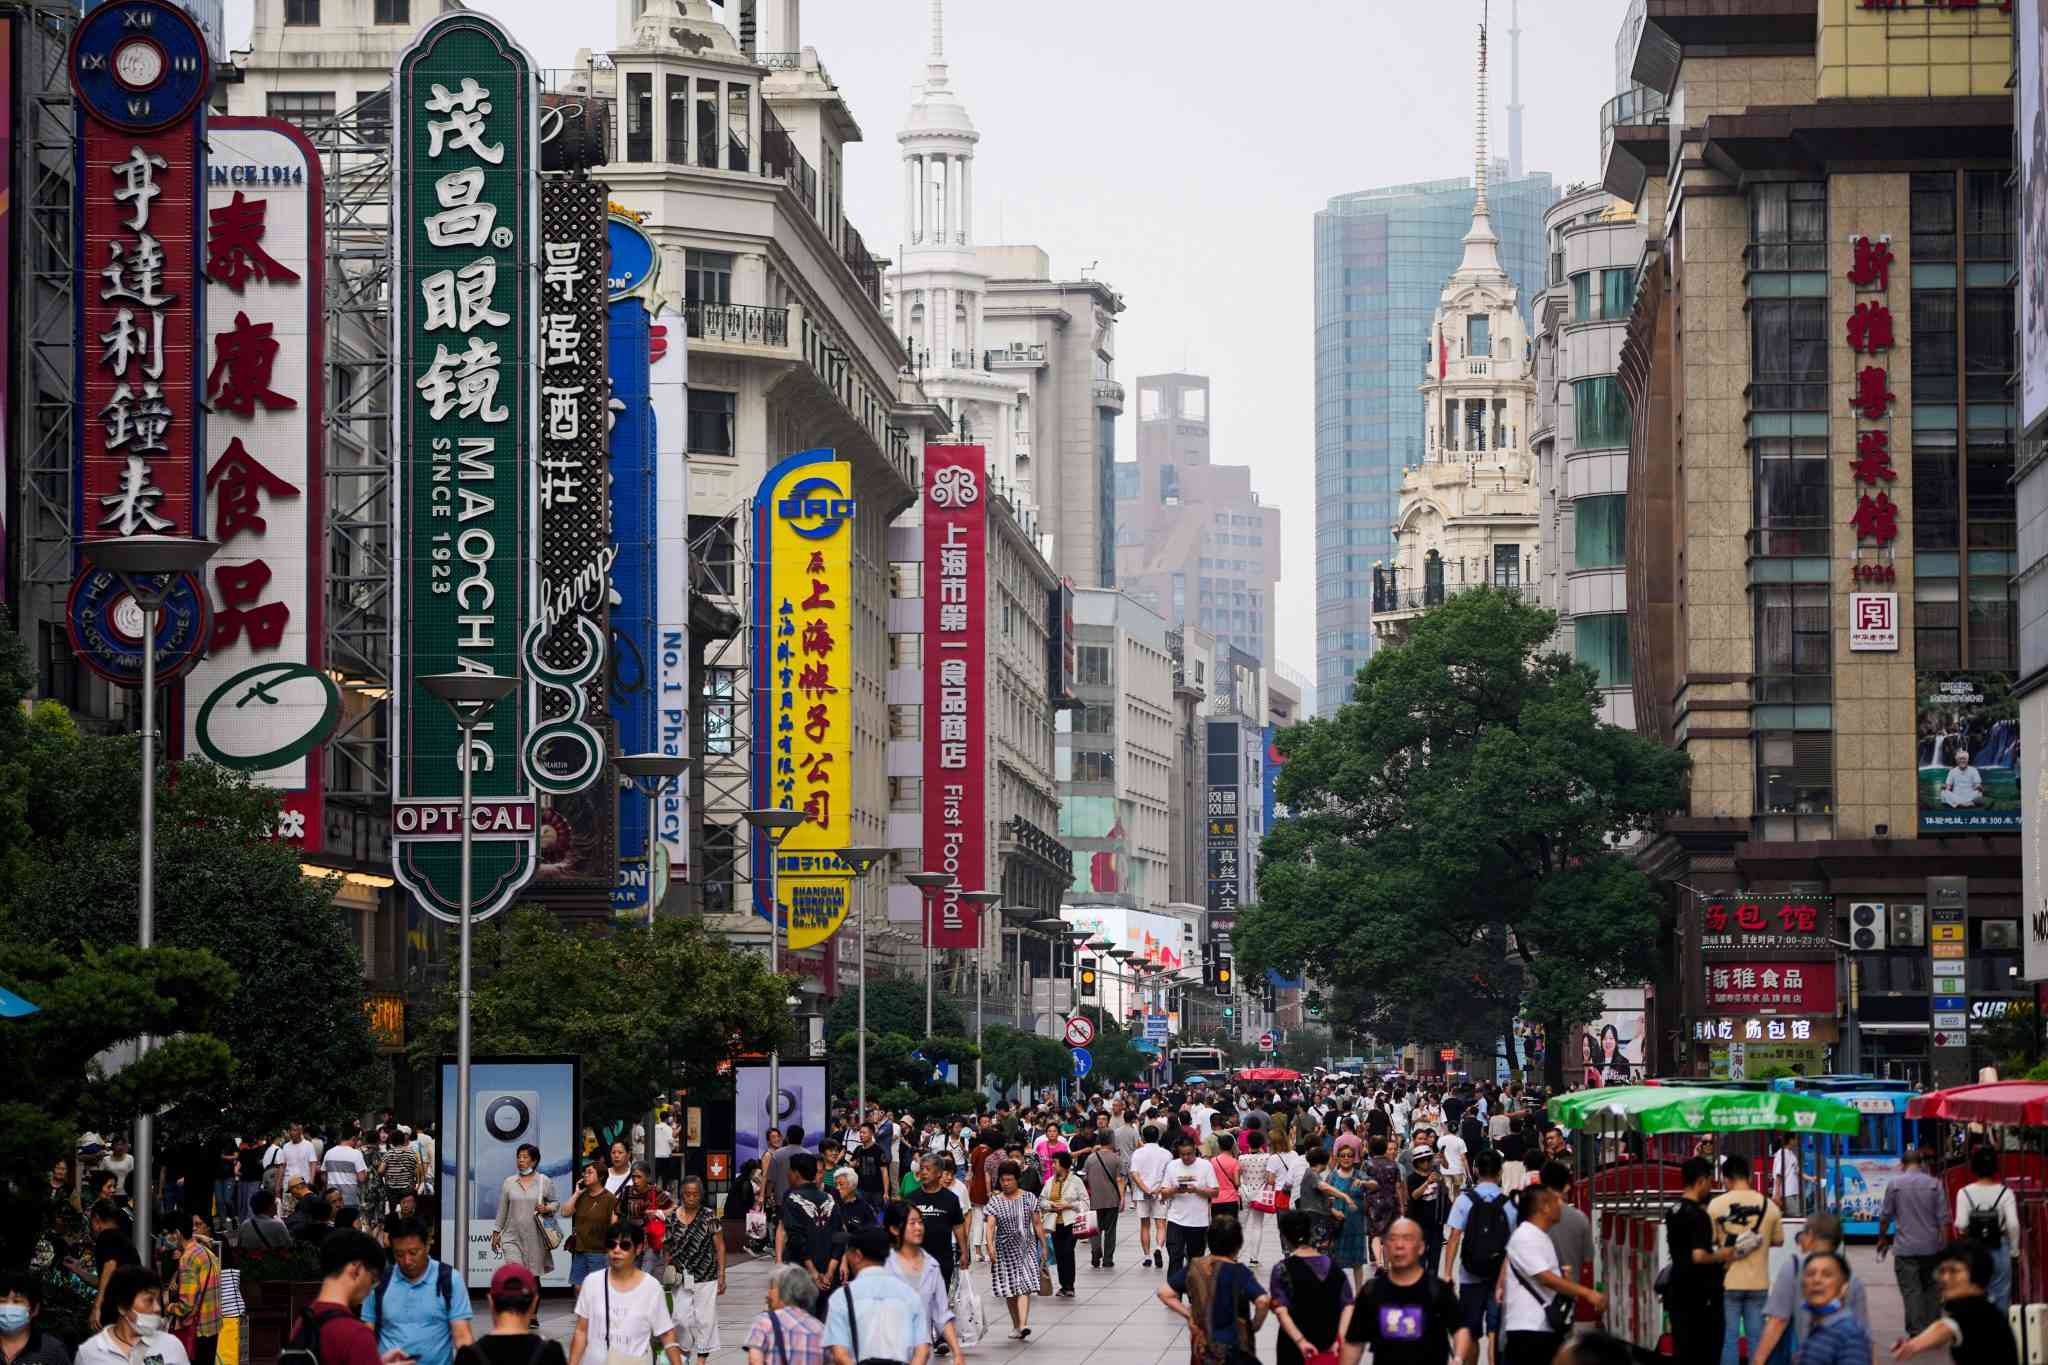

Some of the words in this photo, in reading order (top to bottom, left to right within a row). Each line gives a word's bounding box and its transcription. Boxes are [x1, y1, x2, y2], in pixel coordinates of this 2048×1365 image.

[416, 77, 511, 423] 茂昌眼镜
[205, 190, 303, 656] 泰康食品
[432, 438, 451, 517] SINCE
[432, 533, 451, 593] 1923
[663, 632, 682, 694] No.1
[940, 521, 968, 768] 上海市第一食品商店
[660, 709, 682, 844] Phamacy
[943, 785, 963, 826] First
[397, 806, 533, 833] OPTCAL
[1219, 850, 1237, 909] 真丝大王
[1713, 968, 1803, 989] 新雅食品
[1745, 1020, 1810, 1040] 汤包馆
